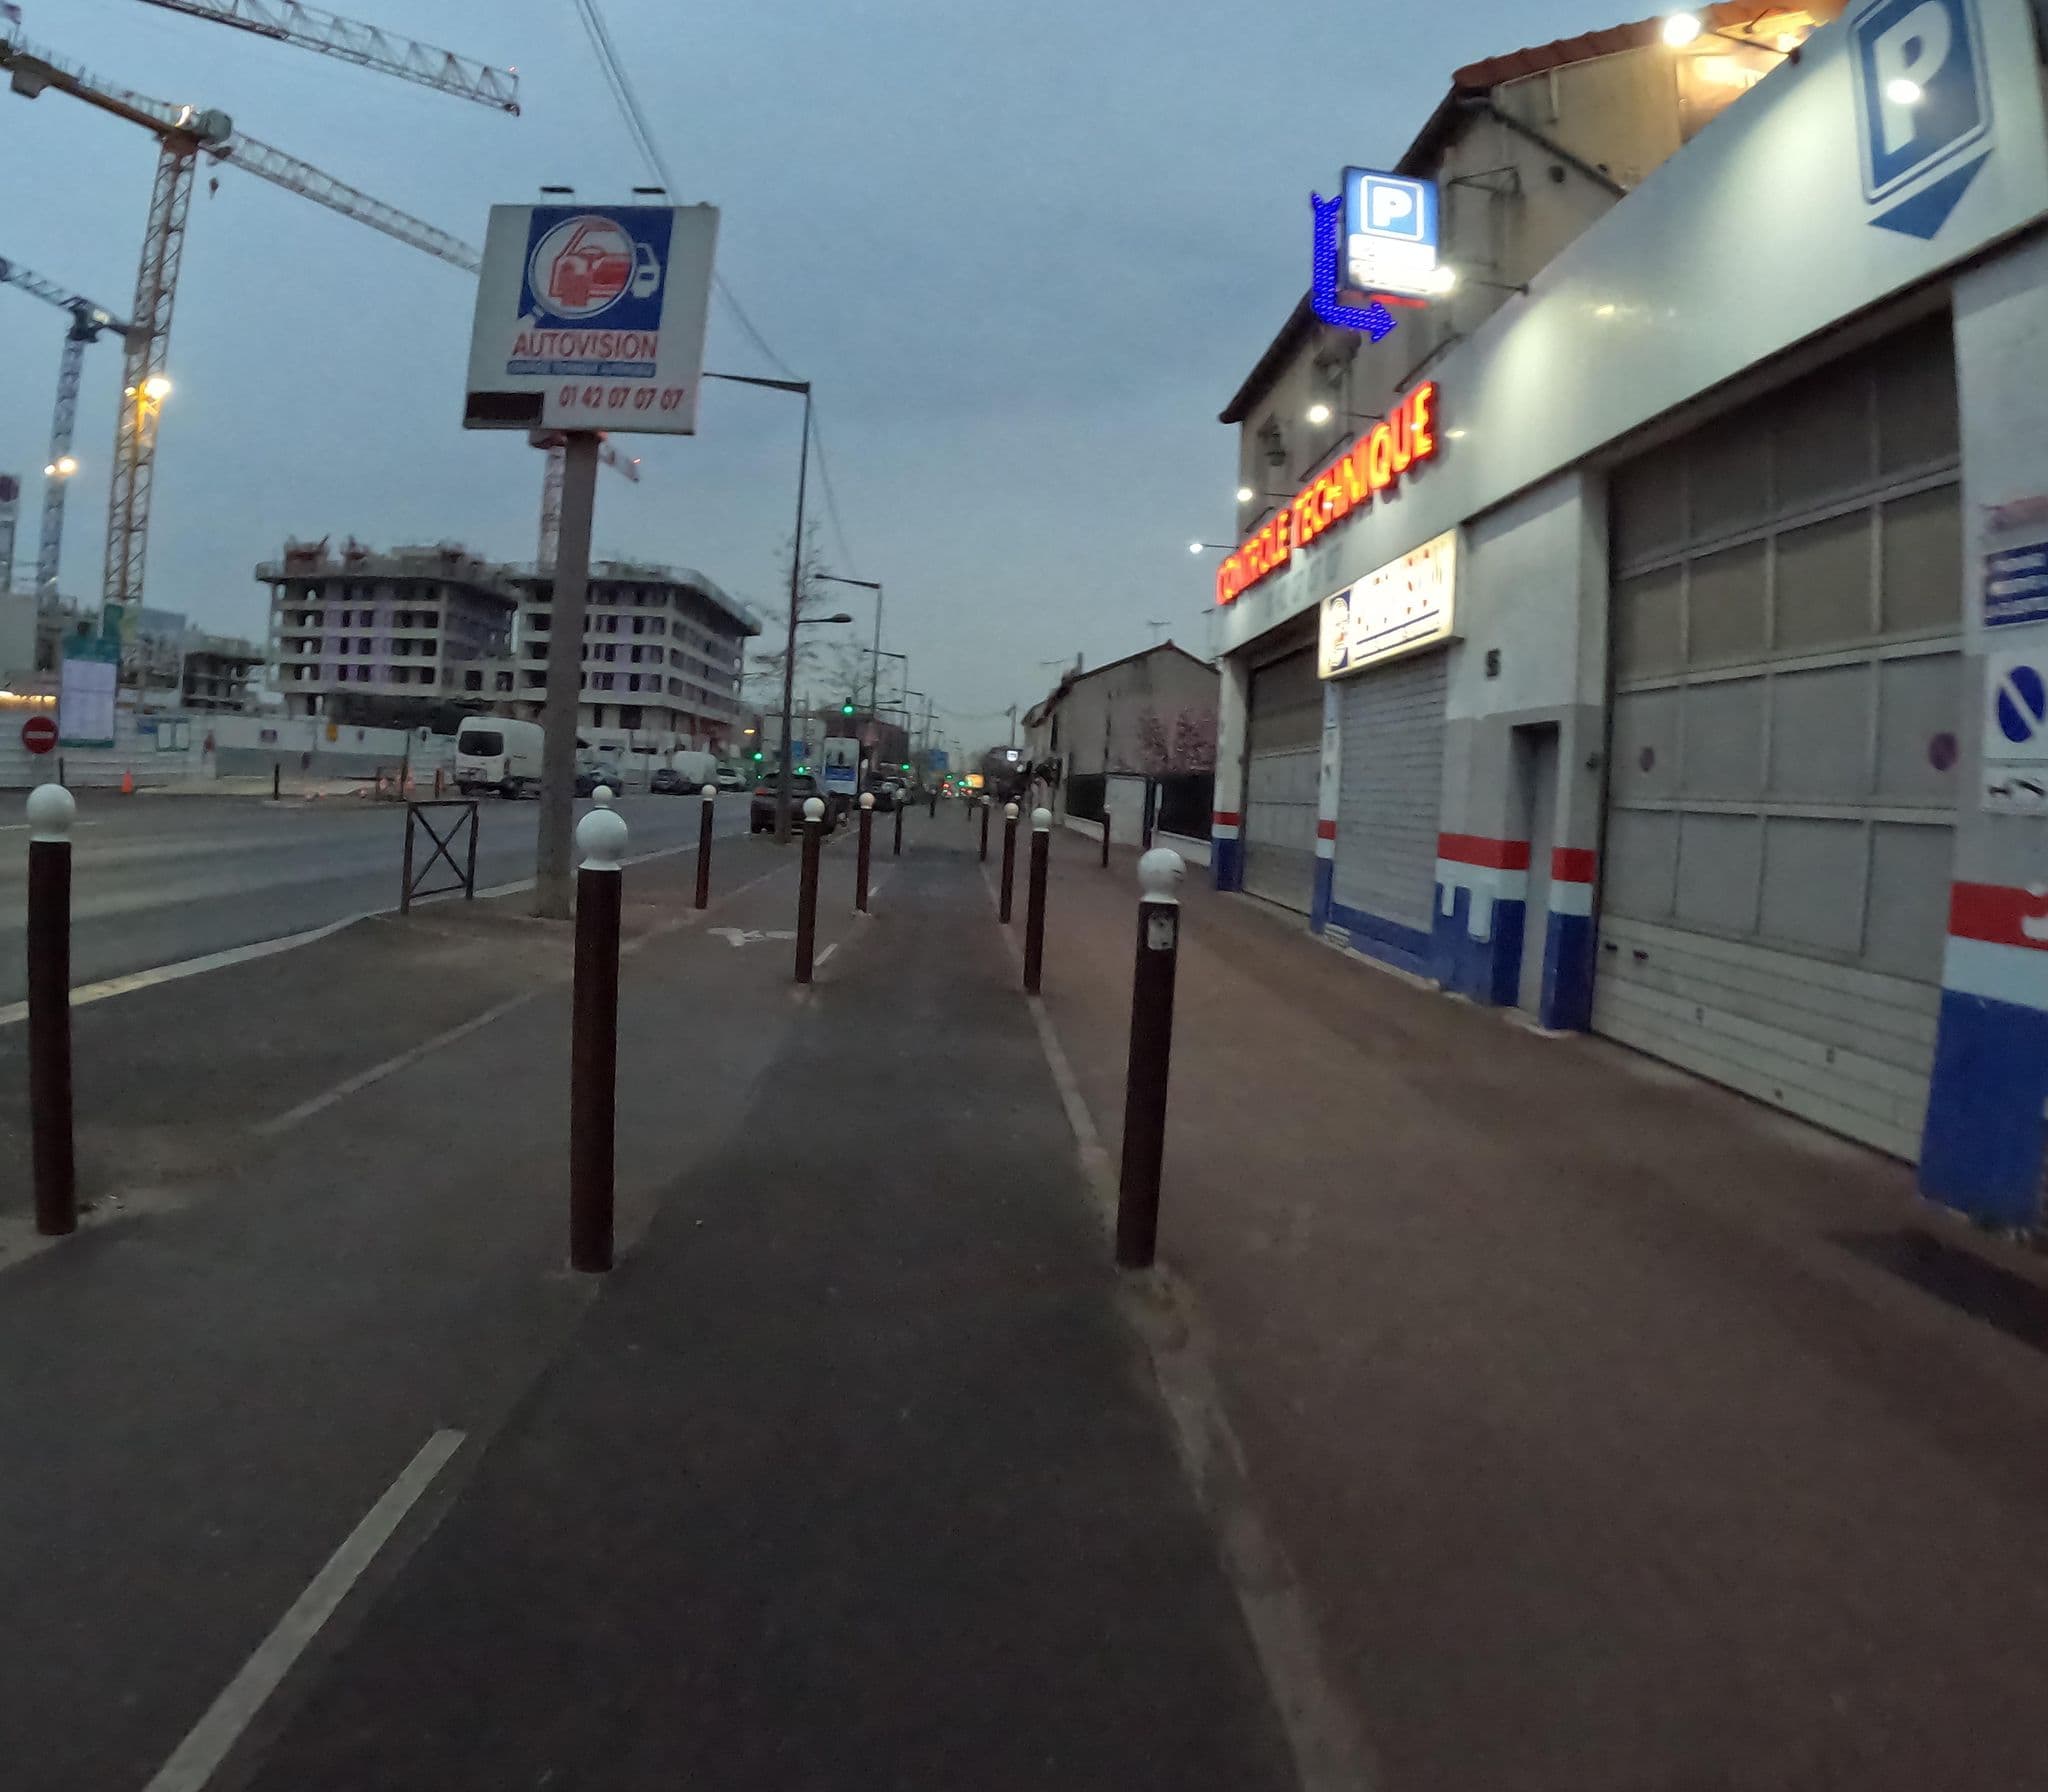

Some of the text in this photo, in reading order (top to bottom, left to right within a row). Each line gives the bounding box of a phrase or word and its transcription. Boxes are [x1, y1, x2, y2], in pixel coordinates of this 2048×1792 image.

[1873, 0, 1952, 156] P
[1372, 186, 1413, 228] P
[512, 332, 658, 359] AUTOVISION
[559, 385, 686, 411] 01 42 07 07 07
